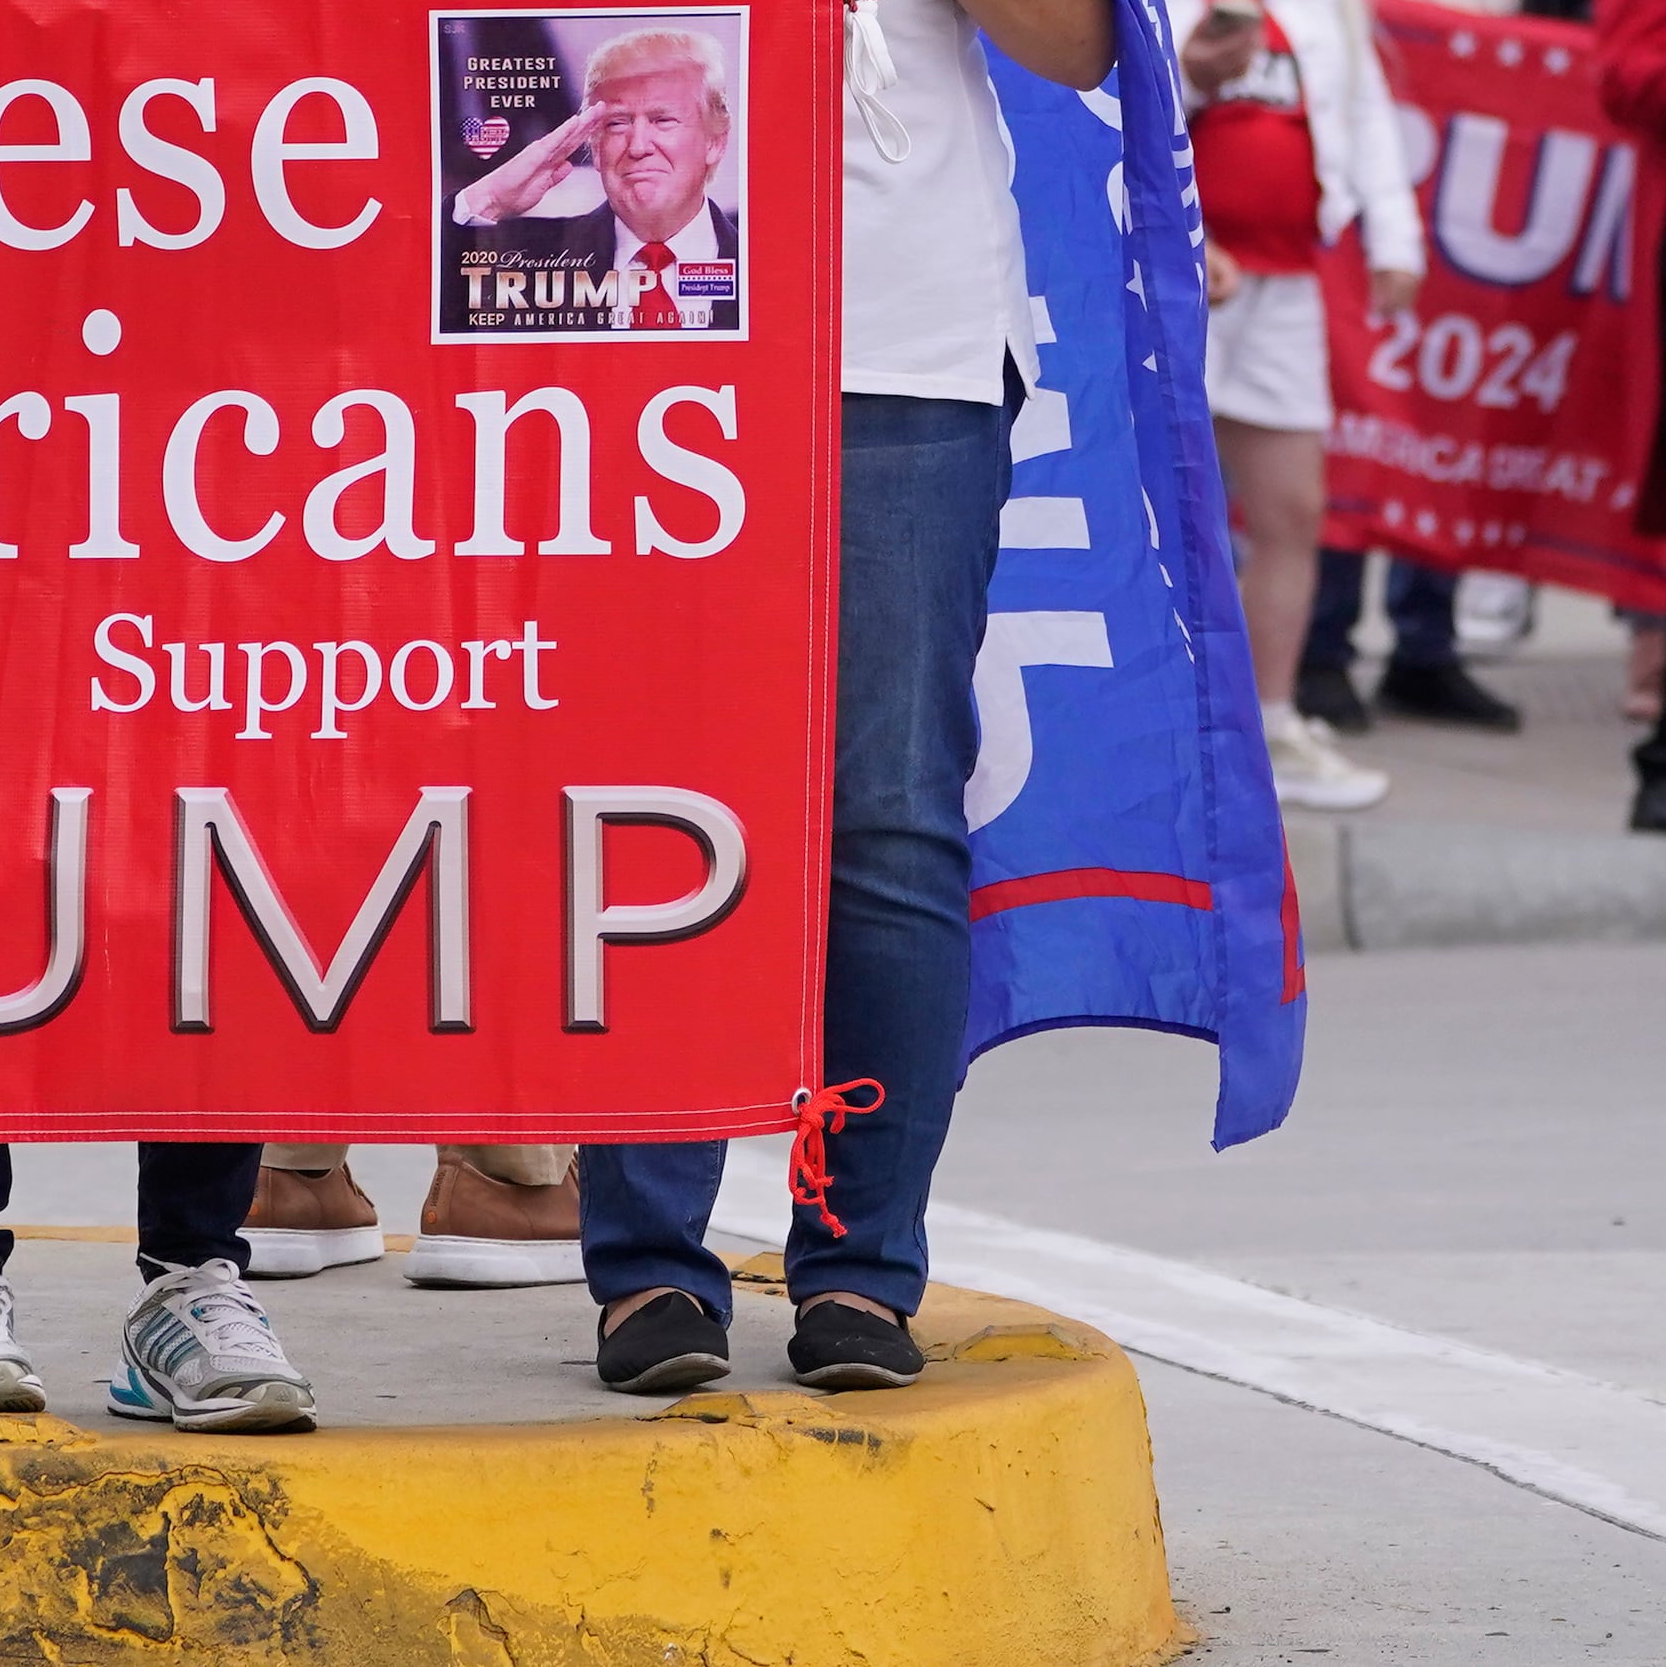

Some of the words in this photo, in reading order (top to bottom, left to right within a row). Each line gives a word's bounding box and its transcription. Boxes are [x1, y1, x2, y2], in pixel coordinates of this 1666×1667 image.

[467, 57, 556, 71] GREATEST
[463, 76, 561, 89] PRESIDENT
[490, 95, 536, 108] EVER
[461, 251, 498, 264] 2020
[495, 248, 597, 268] President
[683, 266, 702, 275] God
[704, 266, 729, 275] Bless
[460, 267, 658, 309] TRUMP
[469, 313, 505, 326] KEEP
[514, 312, 585, 326] AMERICA
[597, 311, 645, 325] GREAT
[1366, 308, 1579, 415] 2024
[91, 612, 558, 739] Support
